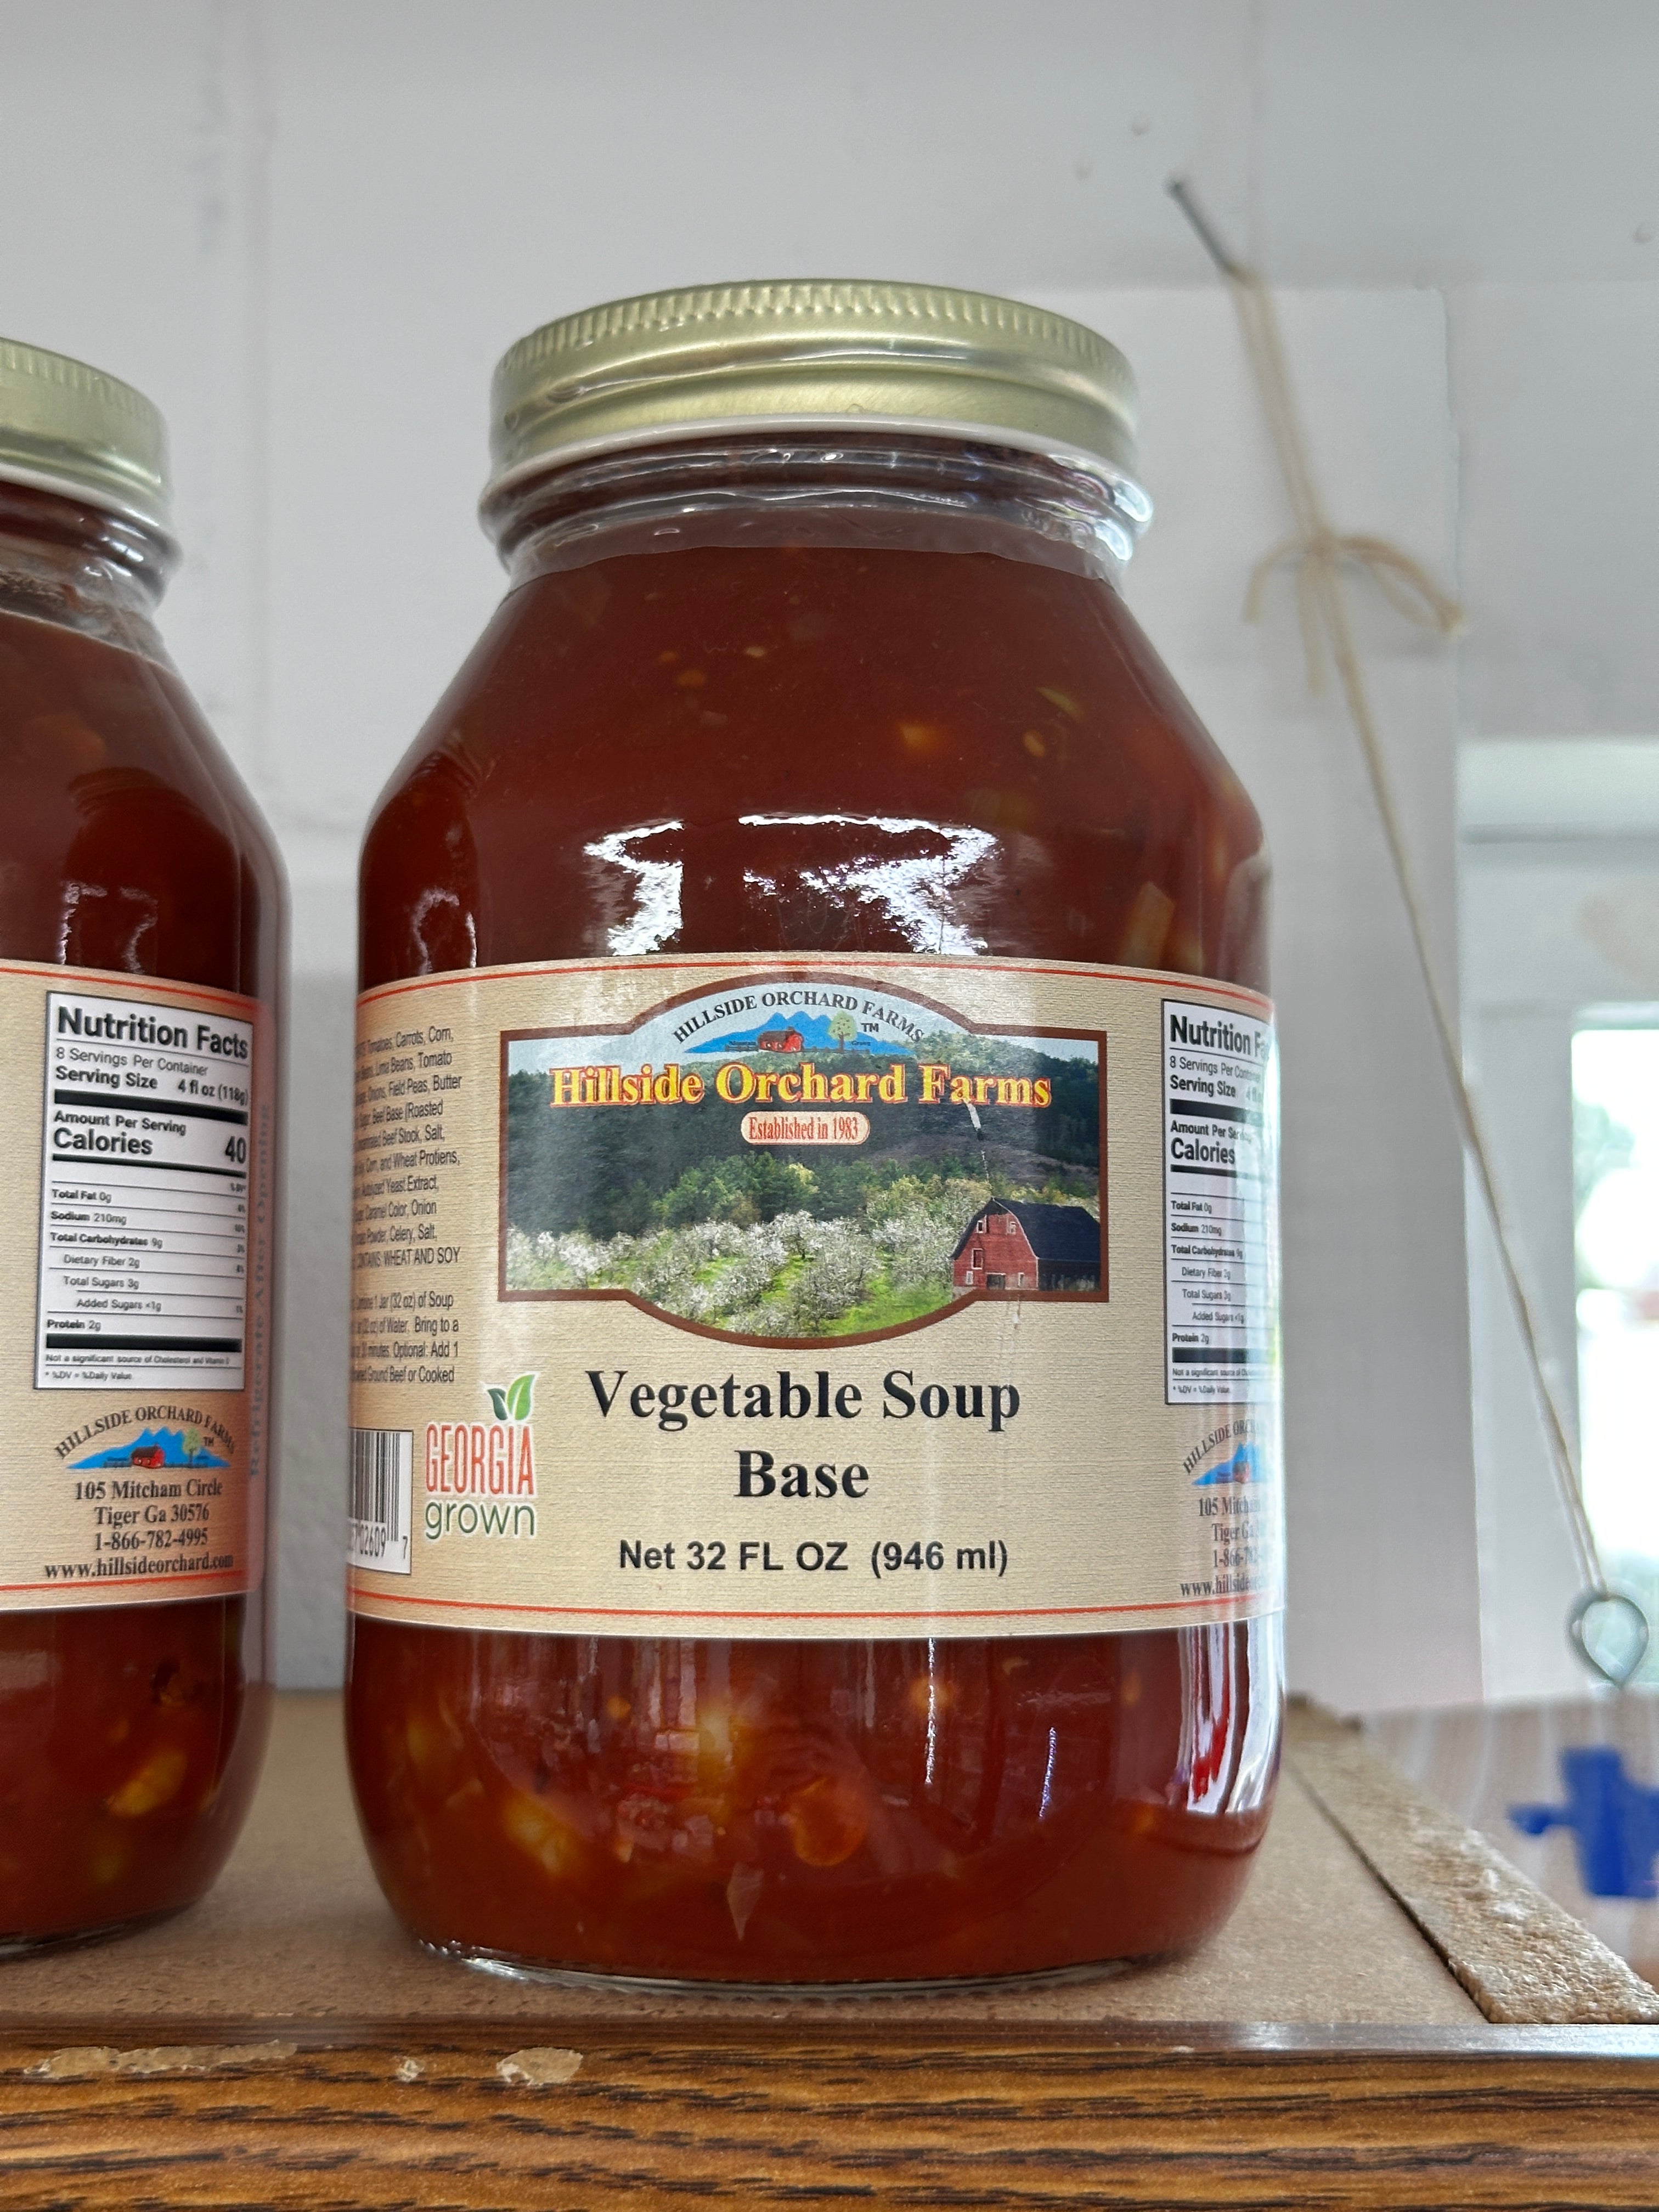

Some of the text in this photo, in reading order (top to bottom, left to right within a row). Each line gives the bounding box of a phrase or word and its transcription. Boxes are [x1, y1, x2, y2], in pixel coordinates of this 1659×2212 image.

[672, 991, 925, 1043] HILLSIDE ORCHARD FARMS
[58, 1006, 249, 1059] Nutrition Facts
[861, 1023, 879, 1032] TM
[1170, 1014, 1250, 1054] Nutrition
[56, 1047, 208, 1076] 8 Servings Per Container
[418, 1051, 452, 1068] Tomato
[1170, 1056, 1176, 1068] 8
[1180, 1057, 1218, 1074] Servings
[1220, 1062, 1233, 1075] Per
[56, 1066, 248, 1106] Serving Size 4 fl oz (118g)
[433, 1075, 462, 1091] Butter
[550, 1062, 1051, 1108] Hillside Orchard Farms
[1170, 1075, 1214, 1097] Serving
[1217, 1081, 1235, 1098] Size
[54, 1110, 186, 1136] Amount Per Serving
[748, 1116, 858, 1139] Established in 1983
[1170, 1119, 1209, 1135] Amount
[1212, 1124, 1226, 1138] Per
[54, 1127, 246, 1164] Calories 40
[1171, 1137, 1235, 1164] Calories
[52, 1189, 112, 1203] Total Fat 0g
[1171, 1200, 1190, 1210] Total
[1192, 1201, 1203, 1211] Fat
[411, 1199, 437, 1216] Onion
[50, 1211, 127, 1226] Sodium 210mg
[1171, 1223, 1198, 1232] Sodium
[50, 1232, 77, 1242] Total
[414, 1248, 434, 1264] AND
[437, 1246, 461, 1263] SOY
[1171, 1244, 1190, 1254] Total
[64, 1254, 140, 1268] Dietary Fiber 2g
[64, 1276, 139, 1289] Total Sugars 3g
[429, 1291, 454, 1311] Soup
[1182, 1289, 1200, 1298] Total
[77, 1299, 108, 1308] Added
[111, 1299, 143, 1310] Sugars
[47, 1319, 101, 1331] Protein 2g
[415, 1316, 437, 1336] Bring
[440, 1317, 449, 1332] to
[453, 1319, 459, 1332] a
[1172, 1333, 1198, 1342] Protein
[430, 1341, 449, 1357] Add
[419, 1365, 454, 1382] Cooked
[585, 1370, 1020, 1432] Vegetable Soup
[54, 1405, 234, 1459] HILLSIDE ORCHARD FARMS
[1182, 1424, 1231, 1474] HILLSIDE
[426, 1424, 534, 1495] GEORGIA
[735, 1449, 869, 1498] Base
[75, 1478, 223, 1499] 105 Mitcham Circle
[94, 1503, 210, 1529] Tiger Ga 30576
[1199, 1497, 1218, 1516] 105
[426, 1502, 535, 1540] grown
[95, 1527, 208, 1550] 1-866-782-4995
[1212, 1523, 1239, 1545] Tiger
[402, 1536, 408, 1559] 7
[44, 1552, 233, 1578] www.hillsideorchard.com
[620, 1539, 1008, 1578] Net 32 FL OZ (946 ml)
